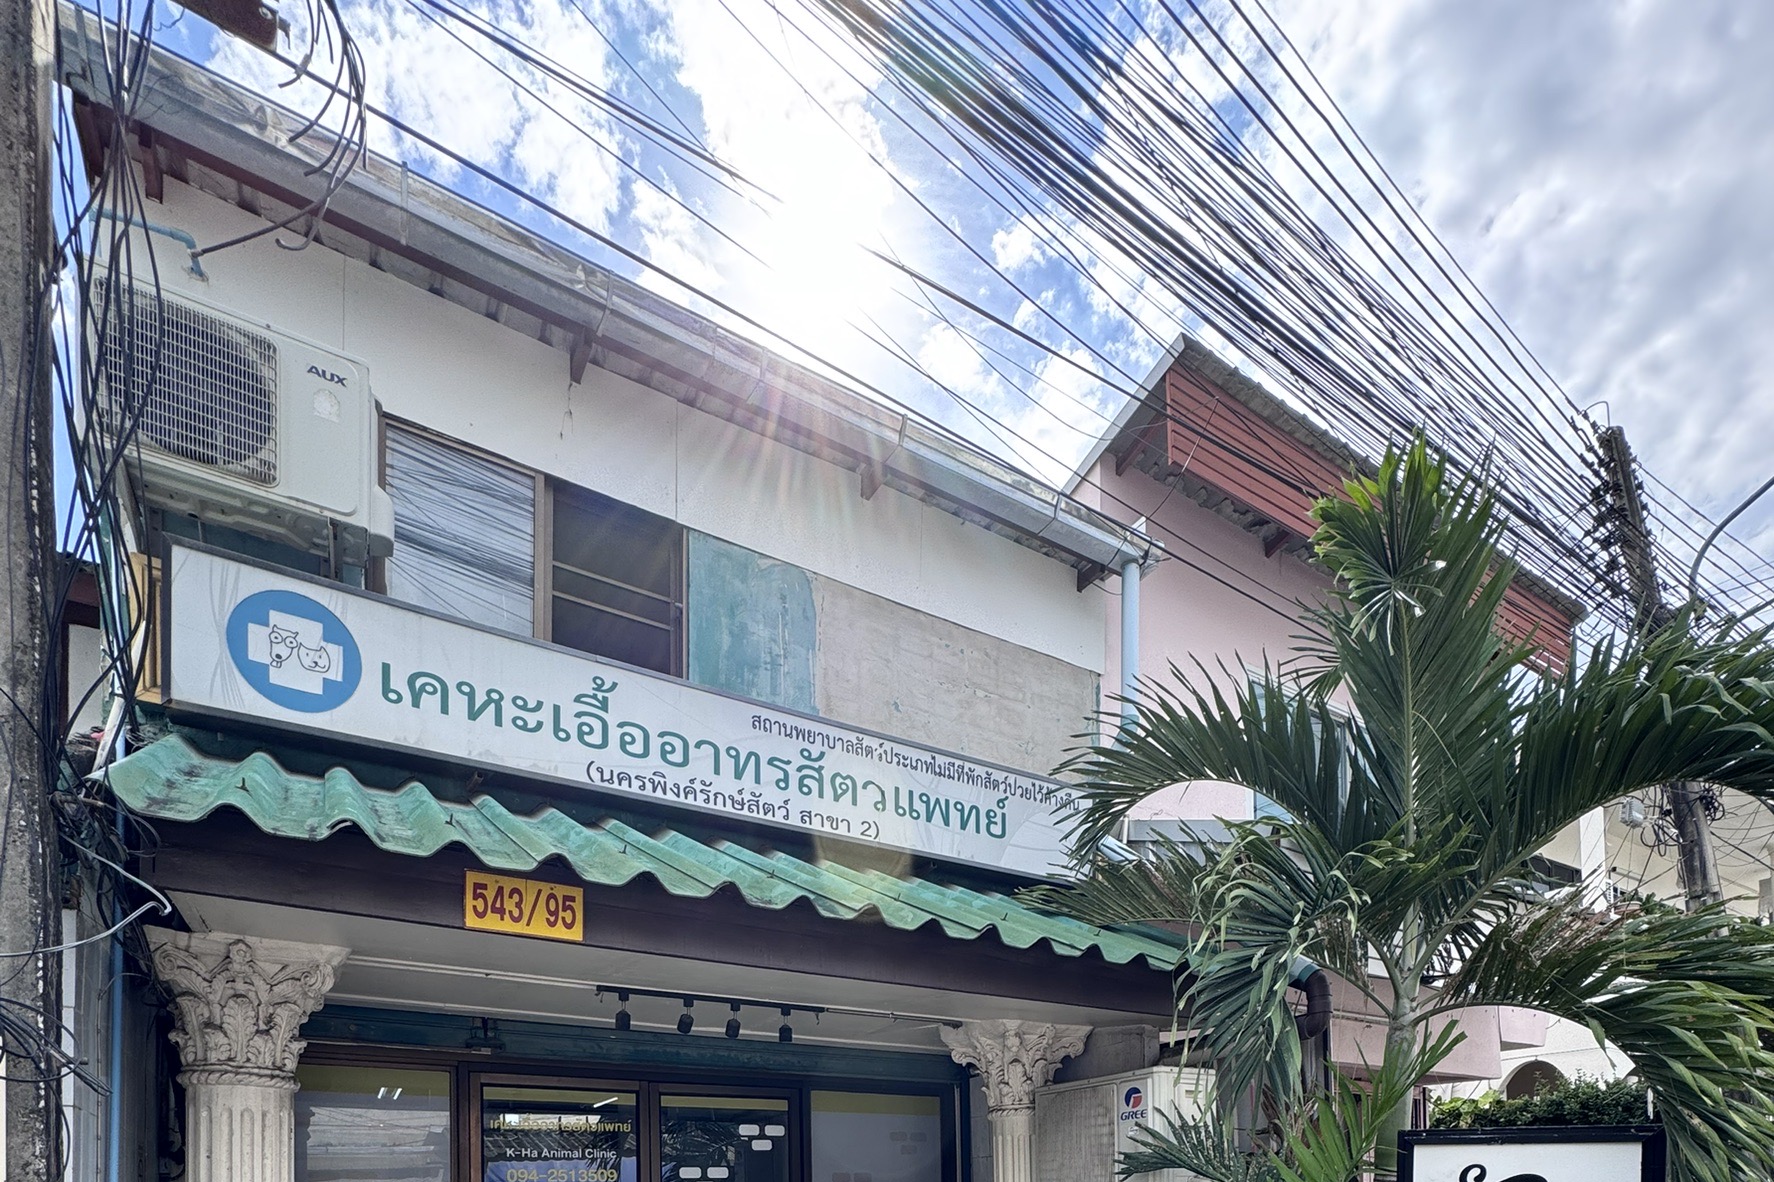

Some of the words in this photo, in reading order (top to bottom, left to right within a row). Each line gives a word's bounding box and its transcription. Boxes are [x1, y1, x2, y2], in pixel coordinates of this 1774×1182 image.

[306, 365, 347, 388] AUX
[381, 661, 1009, 840] เคหะเอื้ออาทรสัตวแพทย์
[586, 760, 791, 821] (นครพิงค์รักษ์สัตว์
[799, 810, 851, 834] สาขา
[860, 820, 880, 840] 2)
[472, 882, 577, 930] 543/95
[1120, 1109, 1147, 1121] GREE
[506, 1148, 539, 1158] K-Ha
[541, 1148, 582, 1159] Animal
[584, 1149, 617, 1159] Clinic
[506, 1168, 618, 1182] 094-2513509
